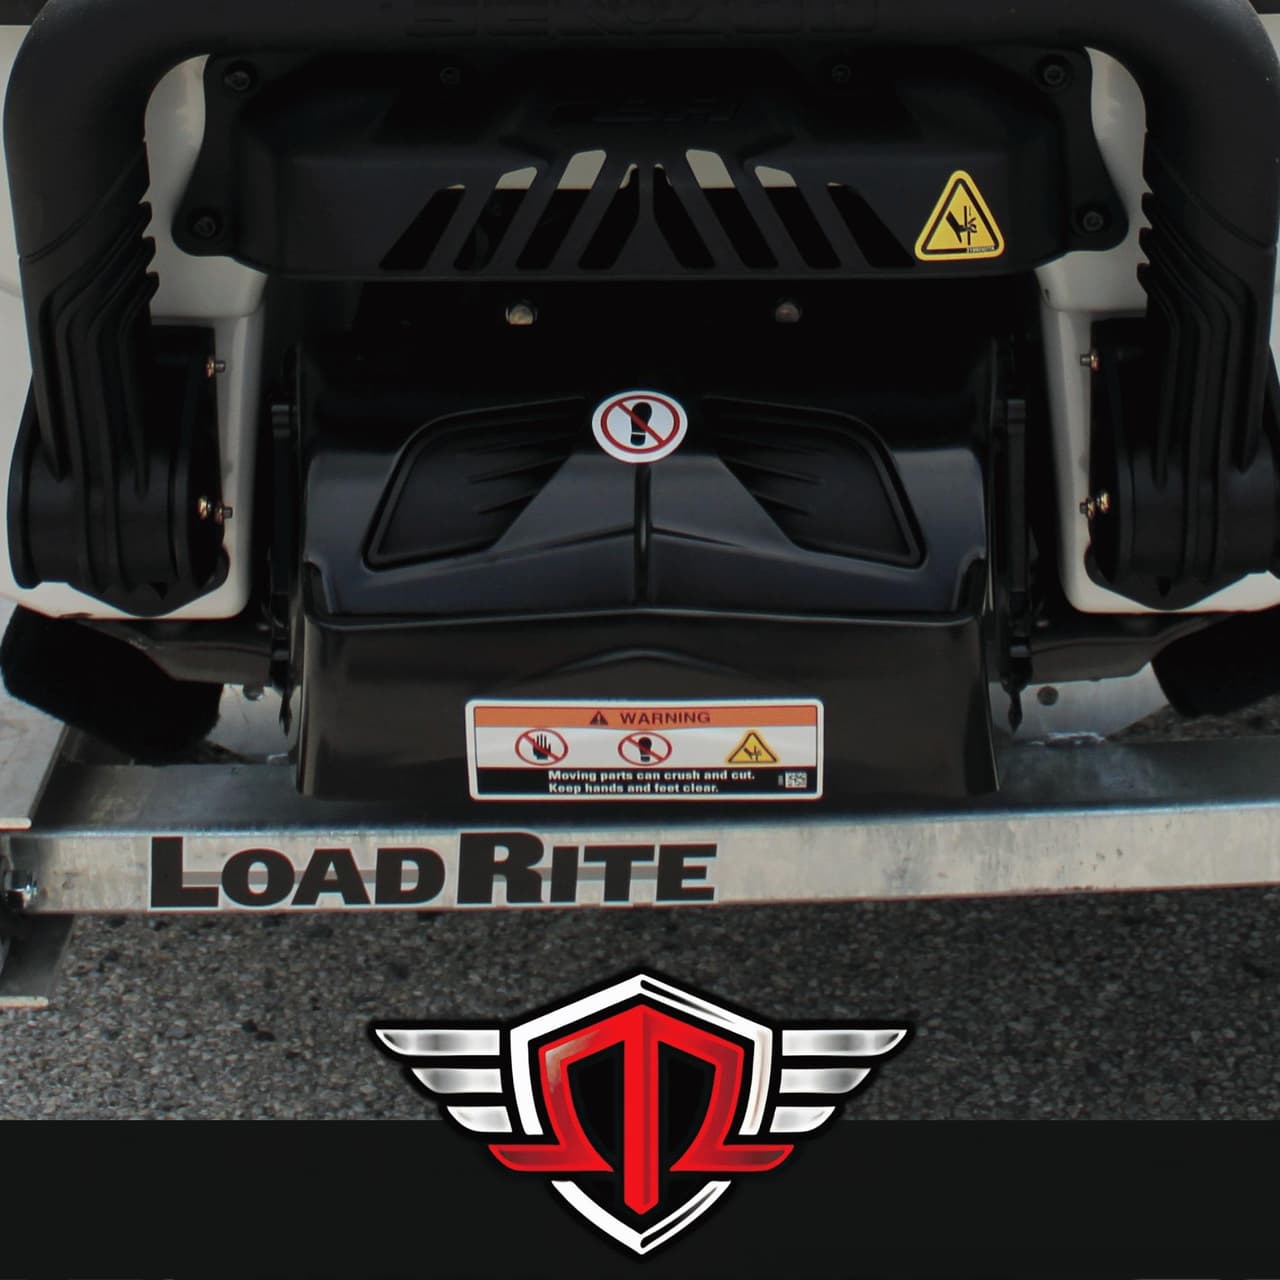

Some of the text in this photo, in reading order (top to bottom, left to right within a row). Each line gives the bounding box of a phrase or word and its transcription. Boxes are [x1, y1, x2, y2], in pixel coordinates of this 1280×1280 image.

[620, 711, 711, 725] WARNING
[548, 770, 755, 783] Moving parts can crush and cut.
[548, 782, 719, 795] Keep hands and feet clear.
